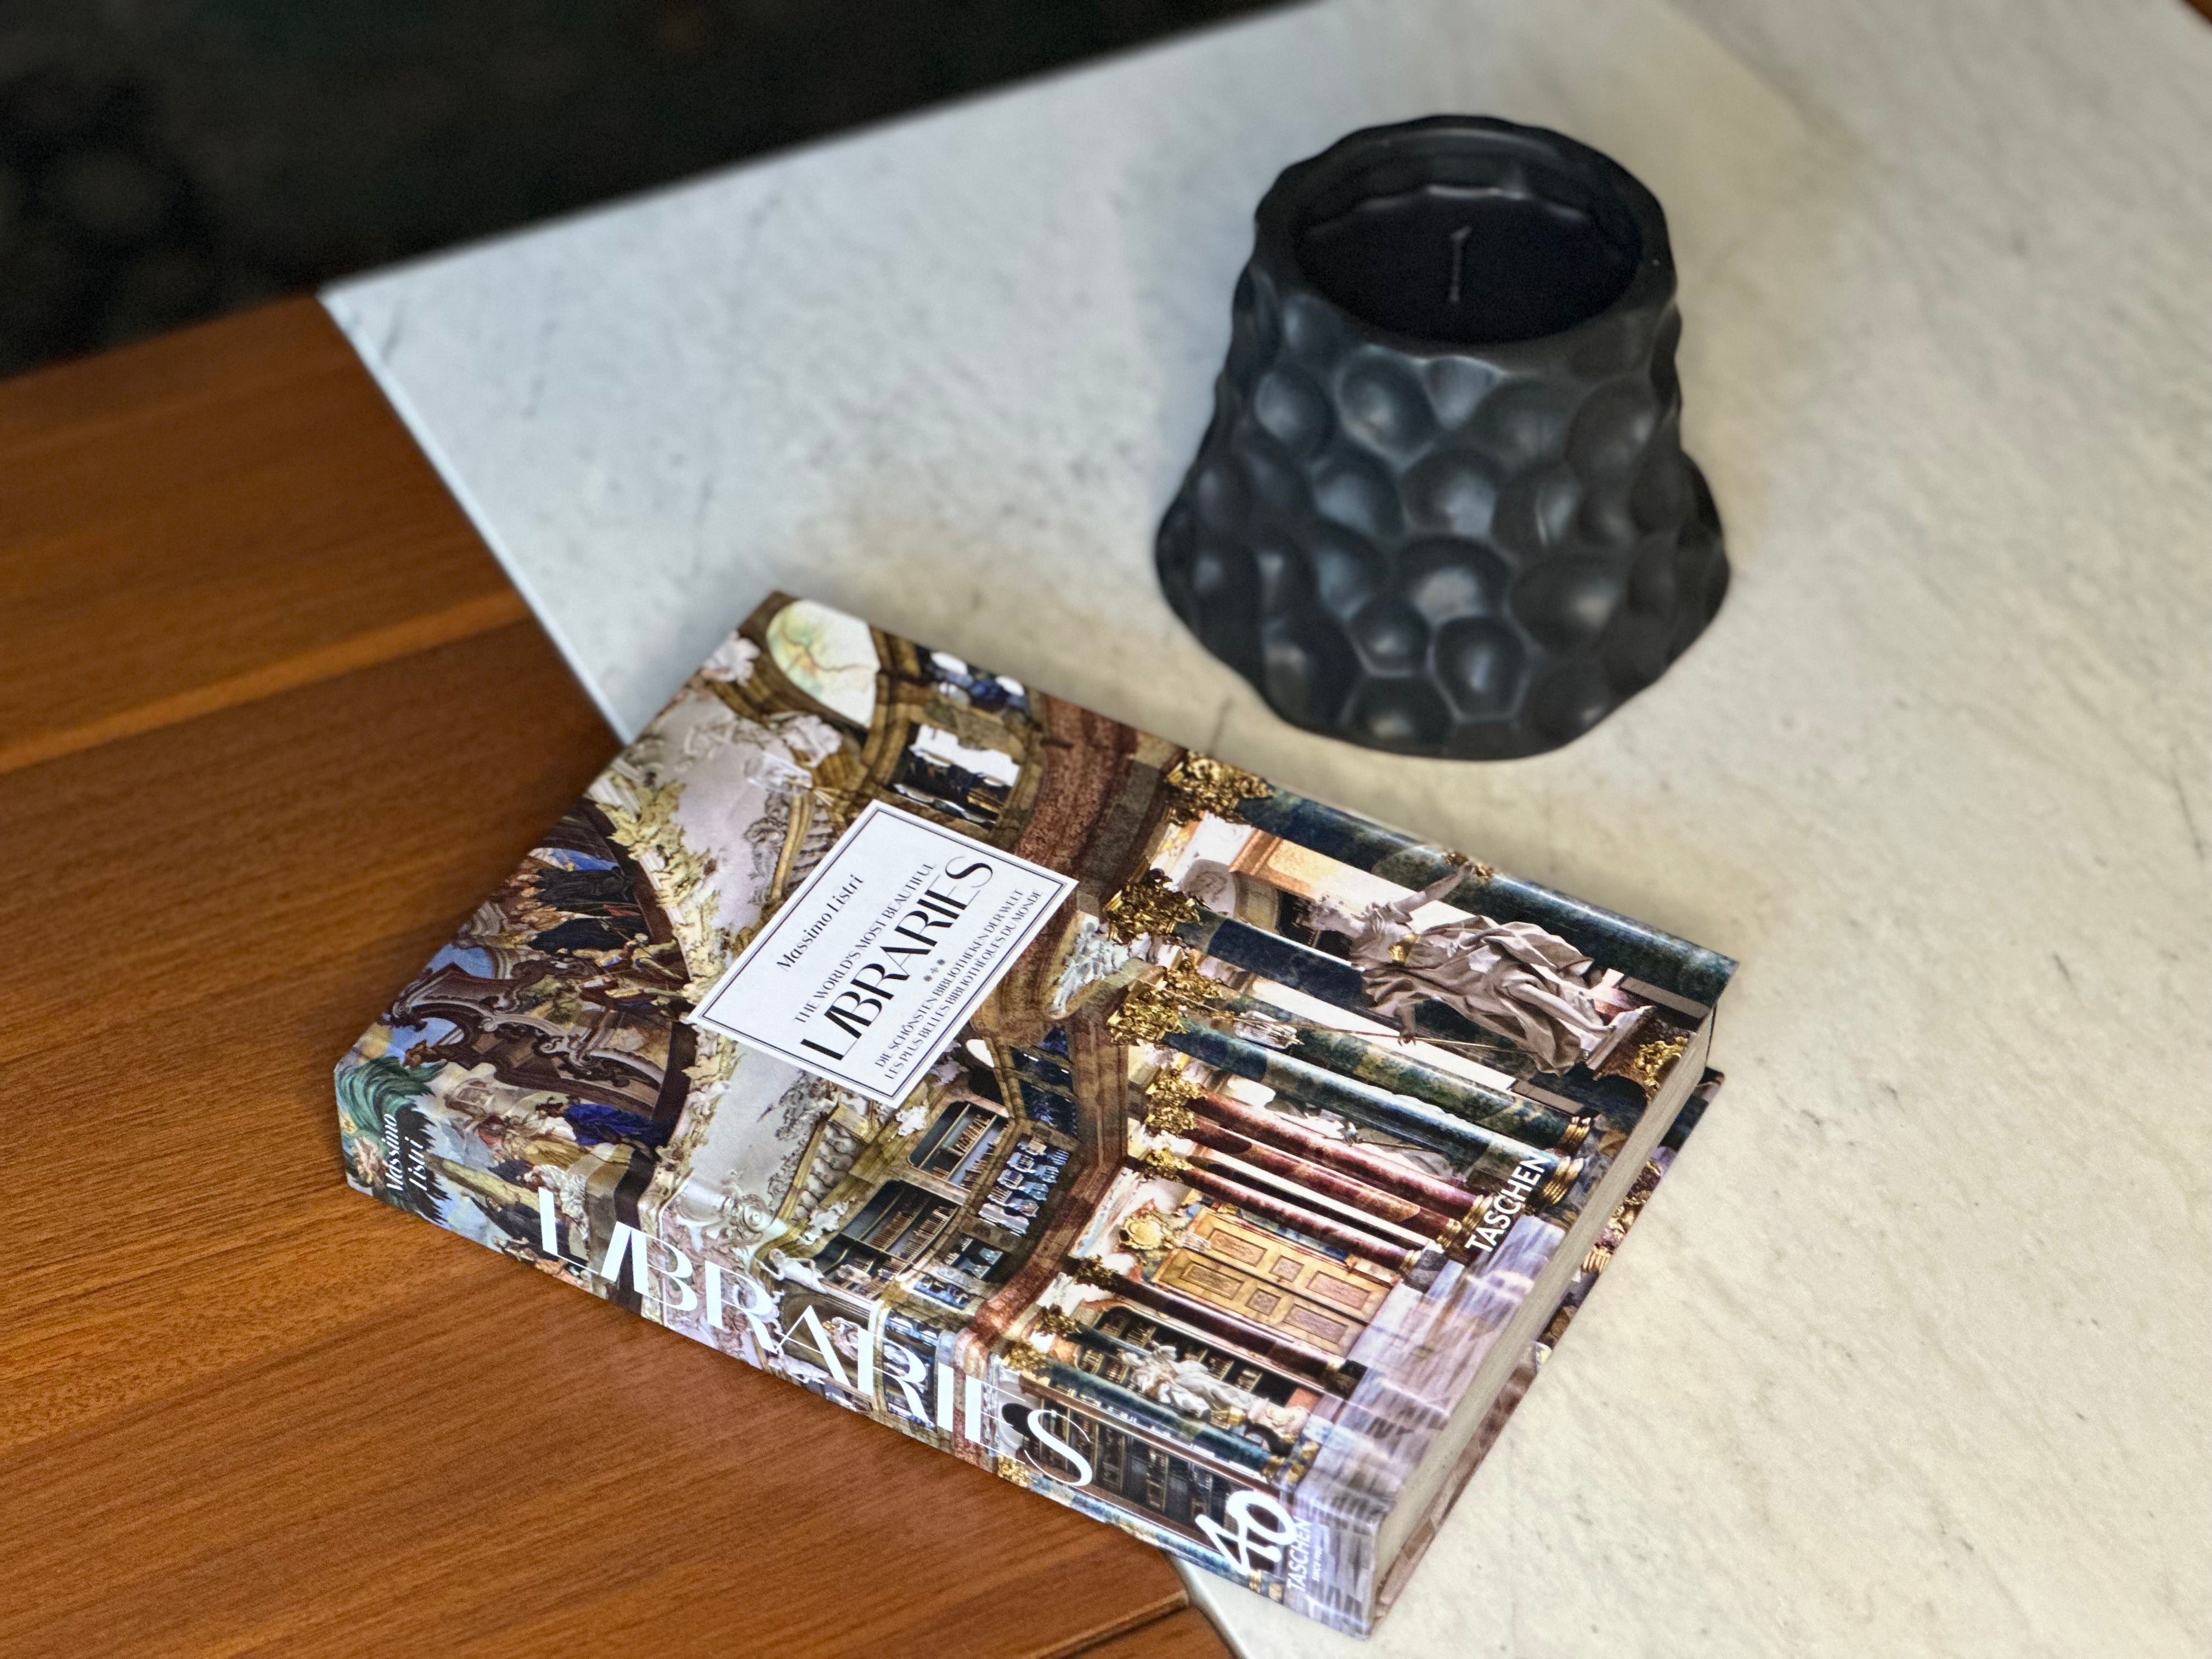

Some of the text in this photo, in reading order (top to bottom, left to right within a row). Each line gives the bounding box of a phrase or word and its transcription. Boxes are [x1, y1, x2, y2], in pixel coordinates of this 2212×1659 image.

[776, 874, 864, 971] Massimo Listri
[793, 865, 936, 1023] THE WORLD'S MOST BEAUTIFUL
[799, 856, 994, 1062] LIBRARIES
[874, 889, 1023, 1067] DIE SCHÖNSTEN BIBLIOTHEKEN DER WELT
[884, 890, 1042, 1079] LES PLUS BELLES BIBLIOTHÈQUES DU MONDE
[1464, 1153, 1551, 1252] TASCHEN
[538, 1186, 1093, 1488] LIBRARIES
[1195, 1490, 1298, 1576] 40
[1287, 1516, 1312, 1592] TASCHEN
[1312, 1561, 1321, 1582] SINCE
